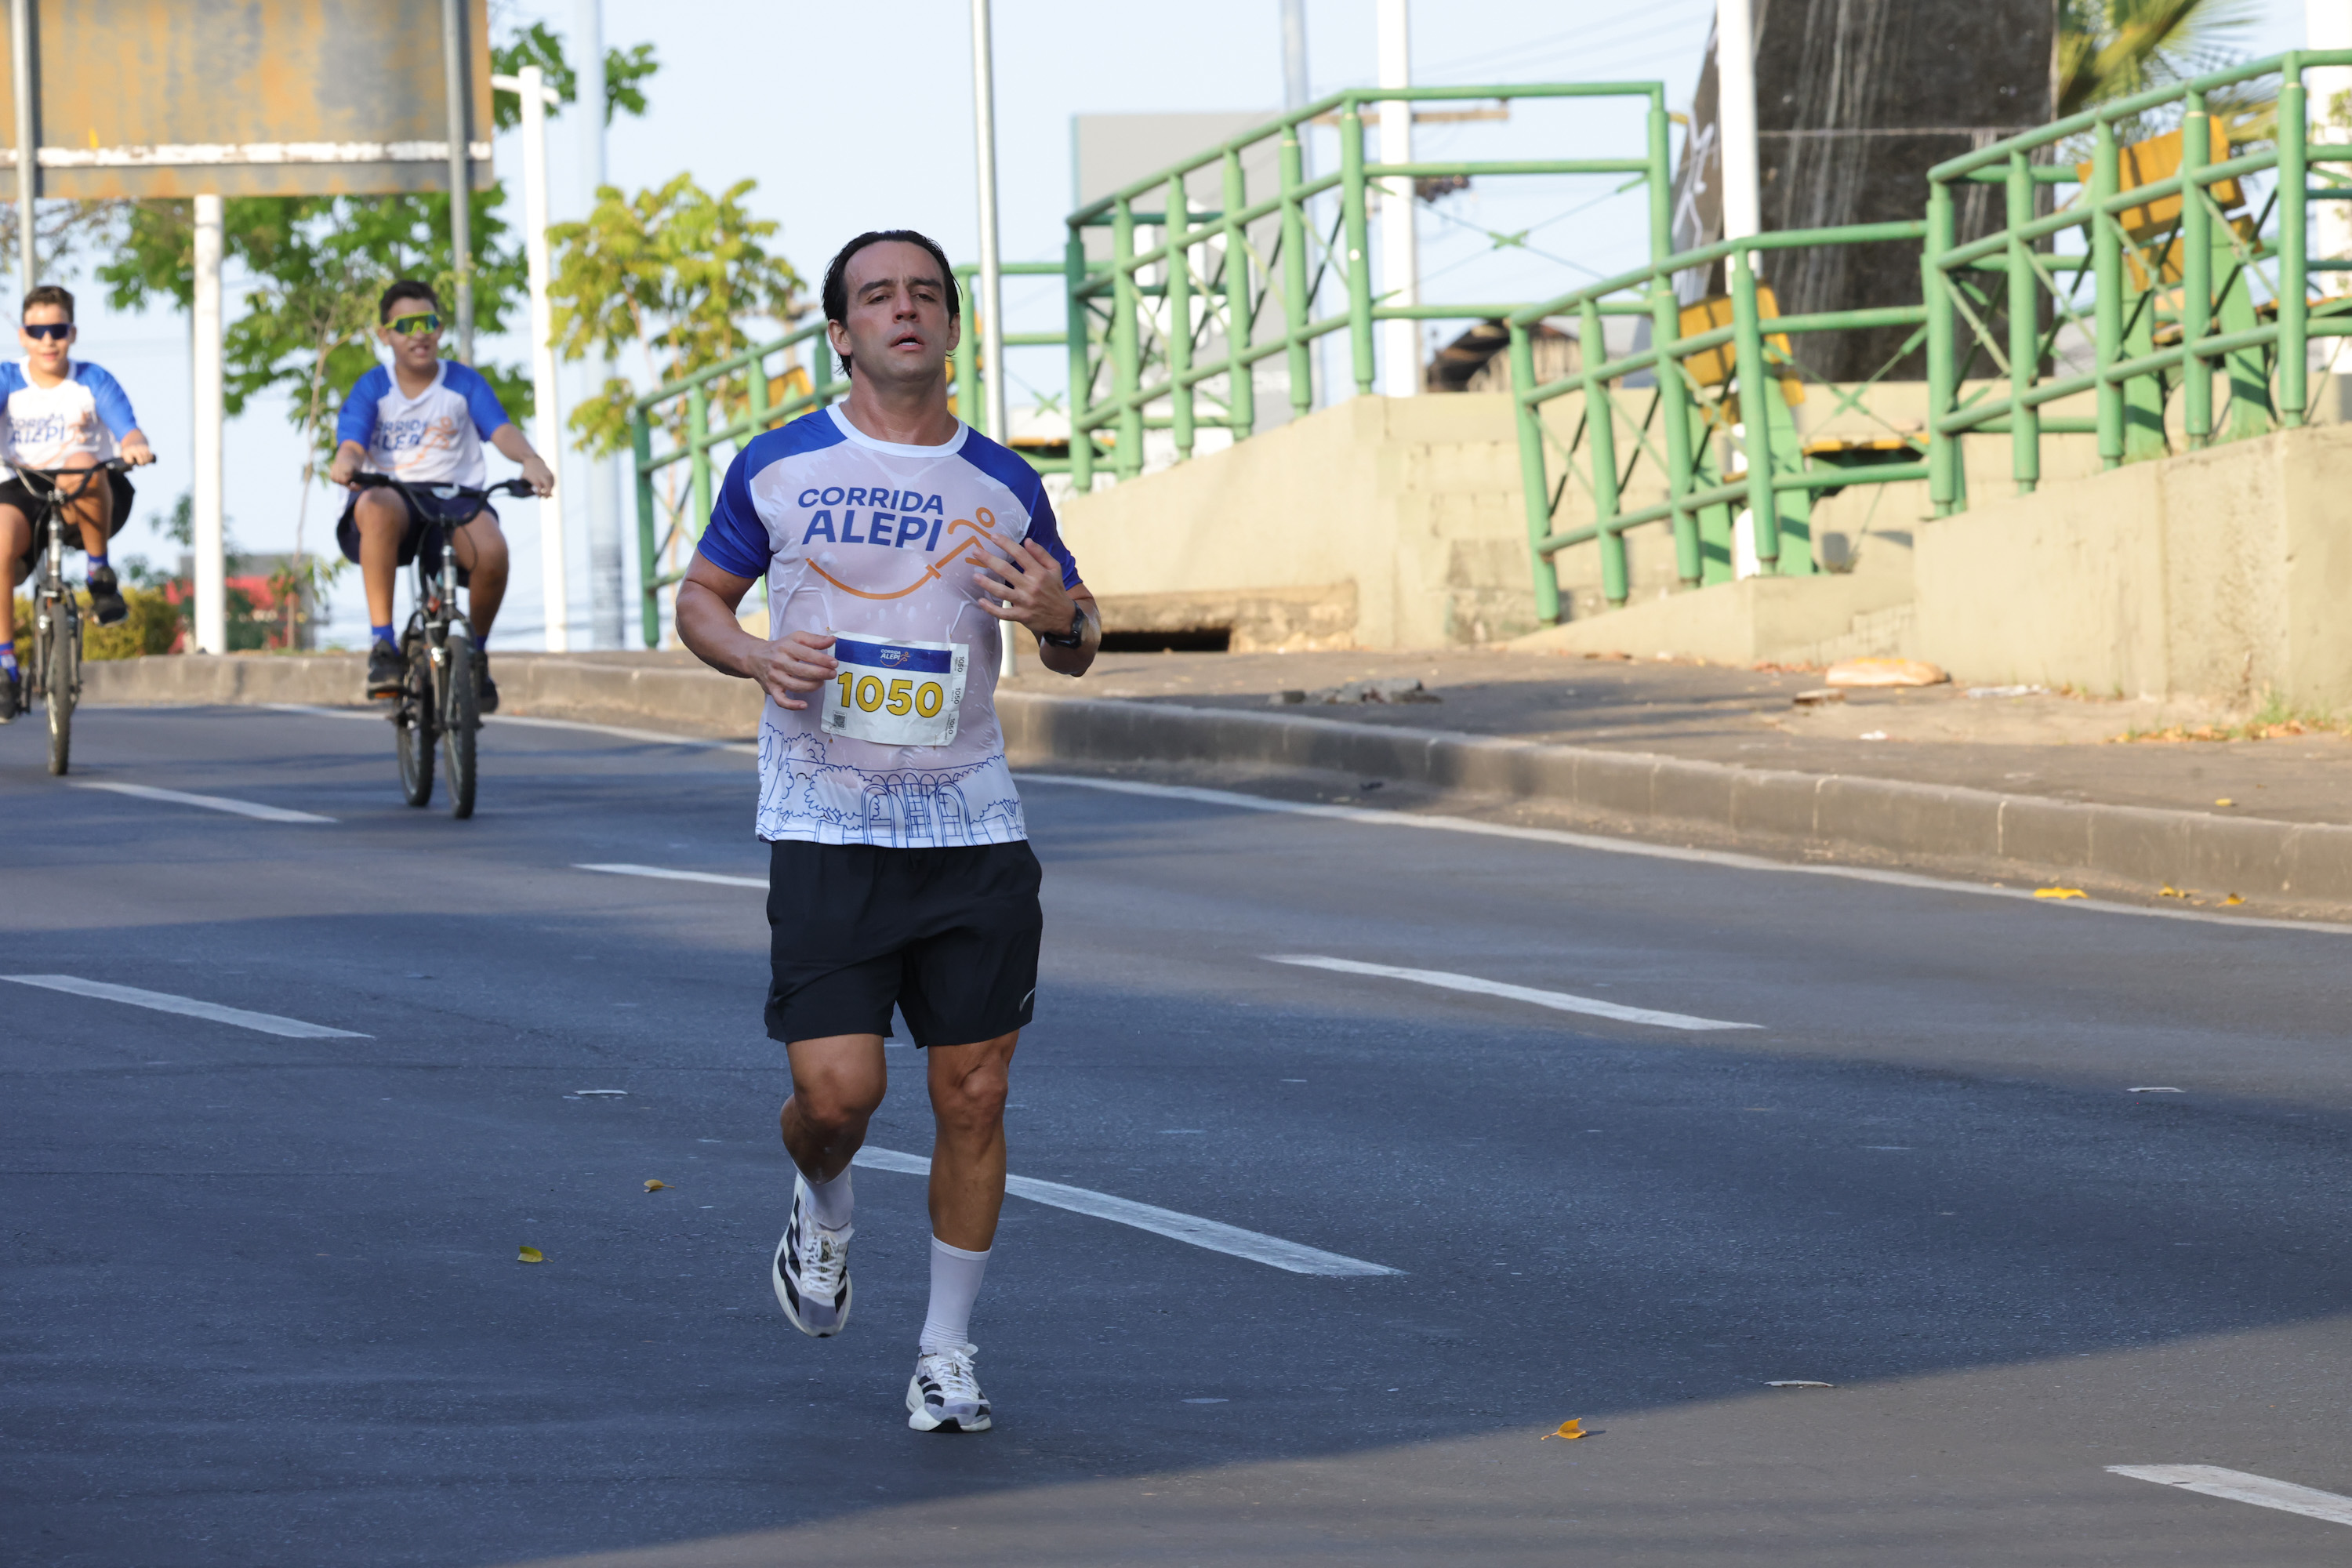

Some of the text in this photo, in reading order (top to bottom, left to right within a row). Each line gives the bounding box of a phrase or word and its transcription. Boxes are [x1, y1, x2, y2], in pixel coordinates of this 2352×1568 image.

[798, 487, 943, 515] CORRIDA
[802, 510, 943, 552] ALEPI
[837, 671, 943, 718] 1050
